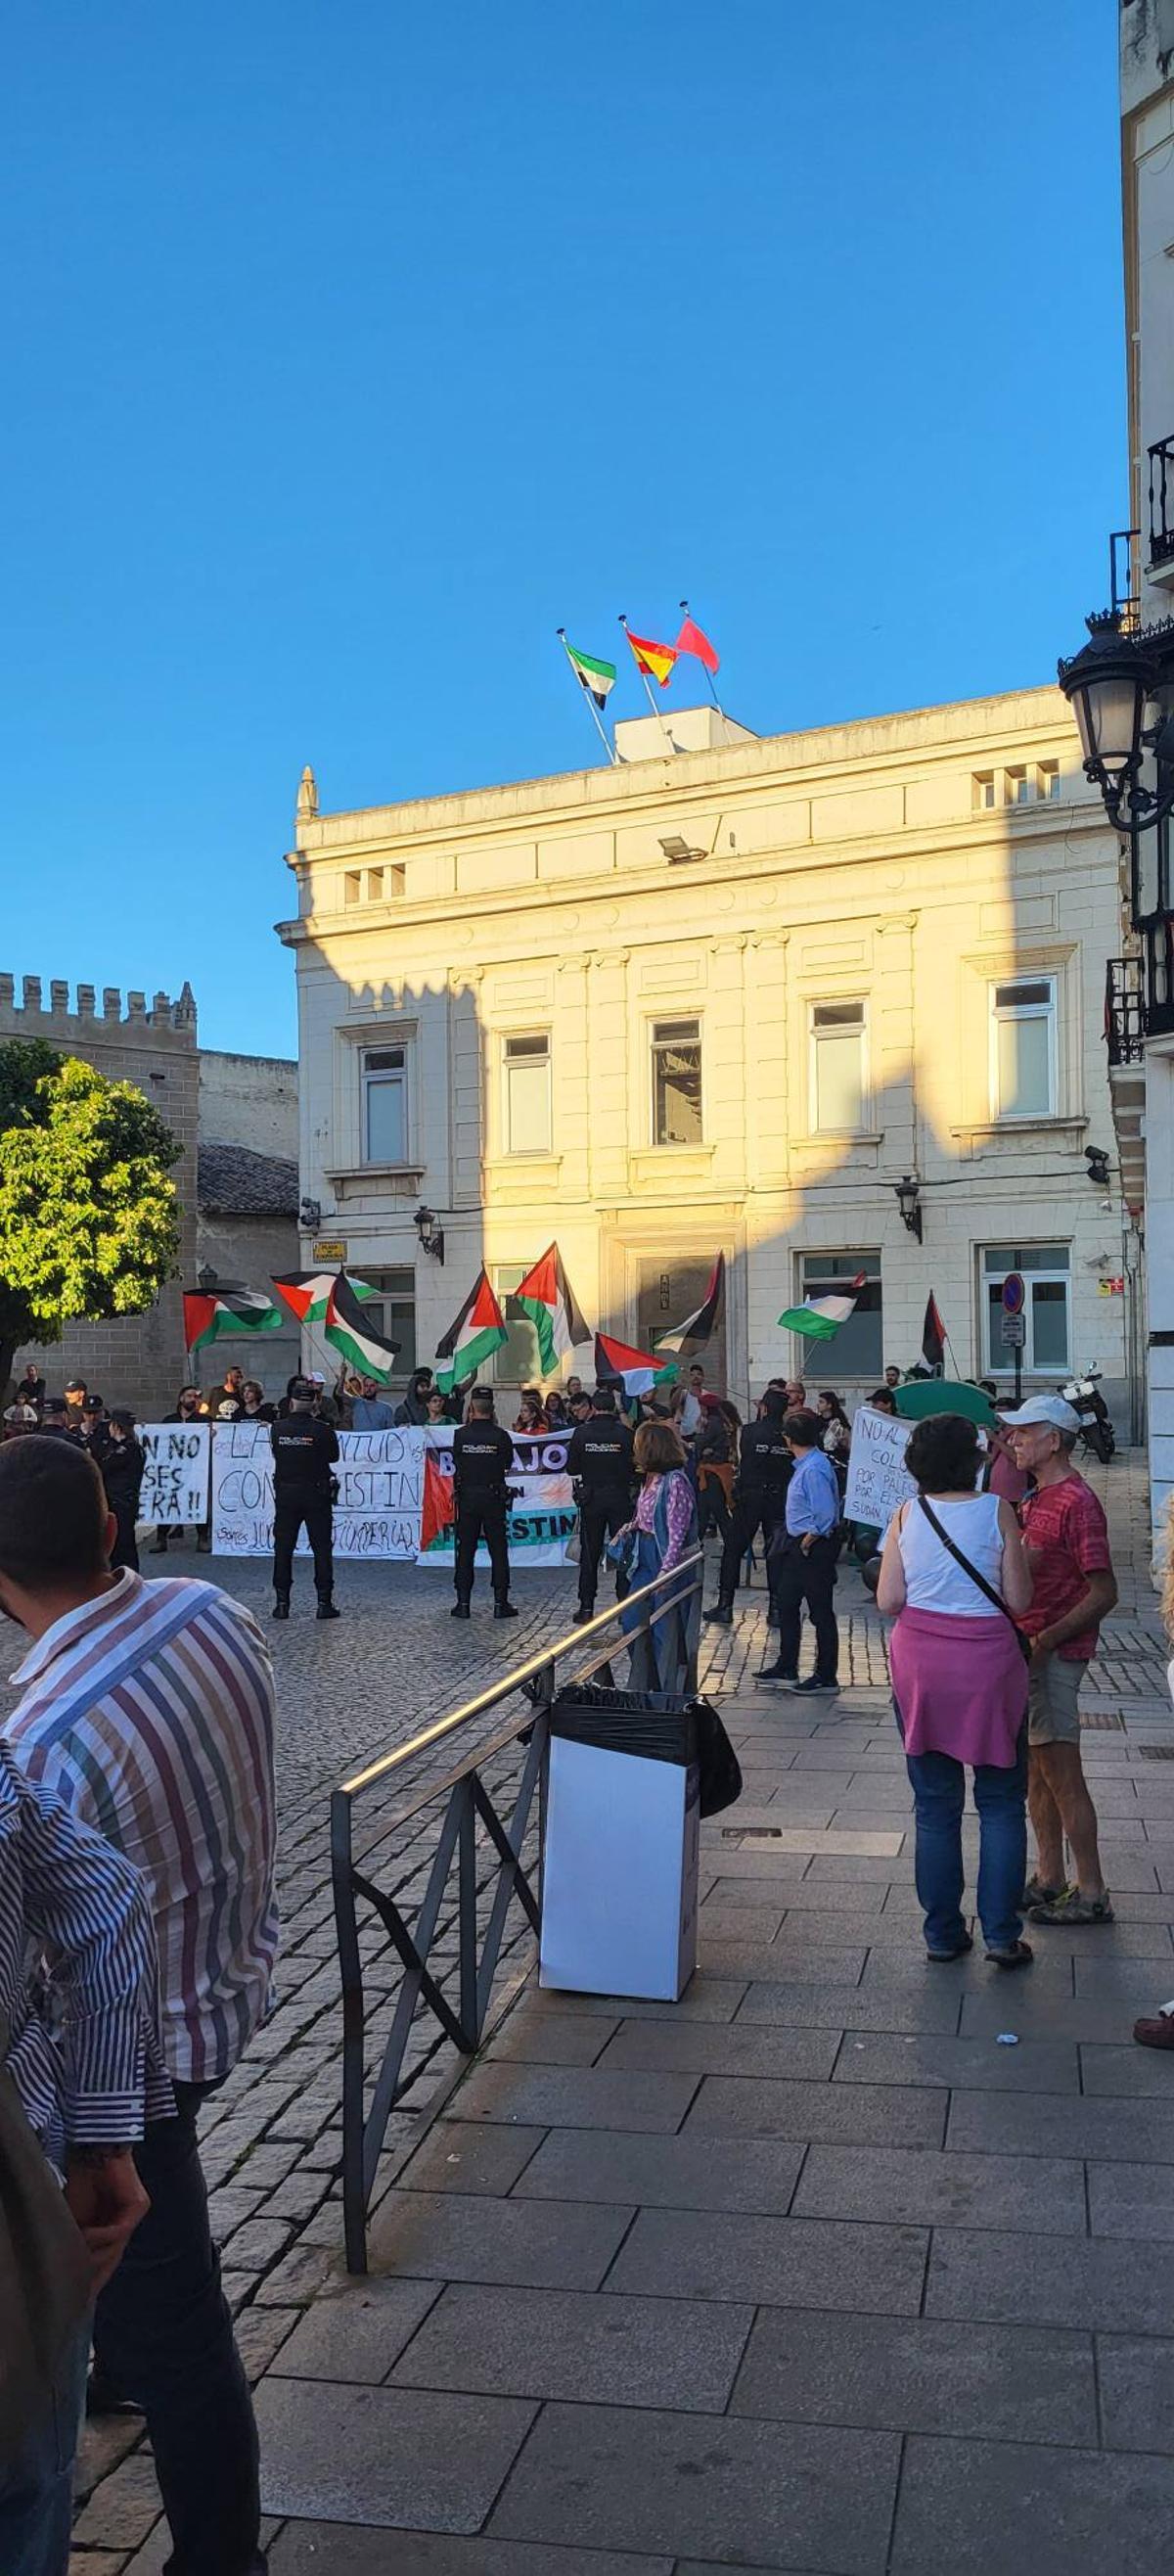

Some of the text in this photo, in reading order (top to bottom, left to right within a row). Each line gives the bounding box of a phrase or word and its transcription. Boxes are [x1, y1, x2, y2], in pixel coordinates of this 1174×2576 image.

[231, 1425, 271, 1458] LA
[862, 1418, 882, 1441] NO
[168, 1434, 201, 1459] NO
[871, 1449, 908, 1472] COLO
[144, 1464, 184, 1492] SES
[856, 1468, 876, 1487] POR
[883, 1474, 918, 1498] PALES
